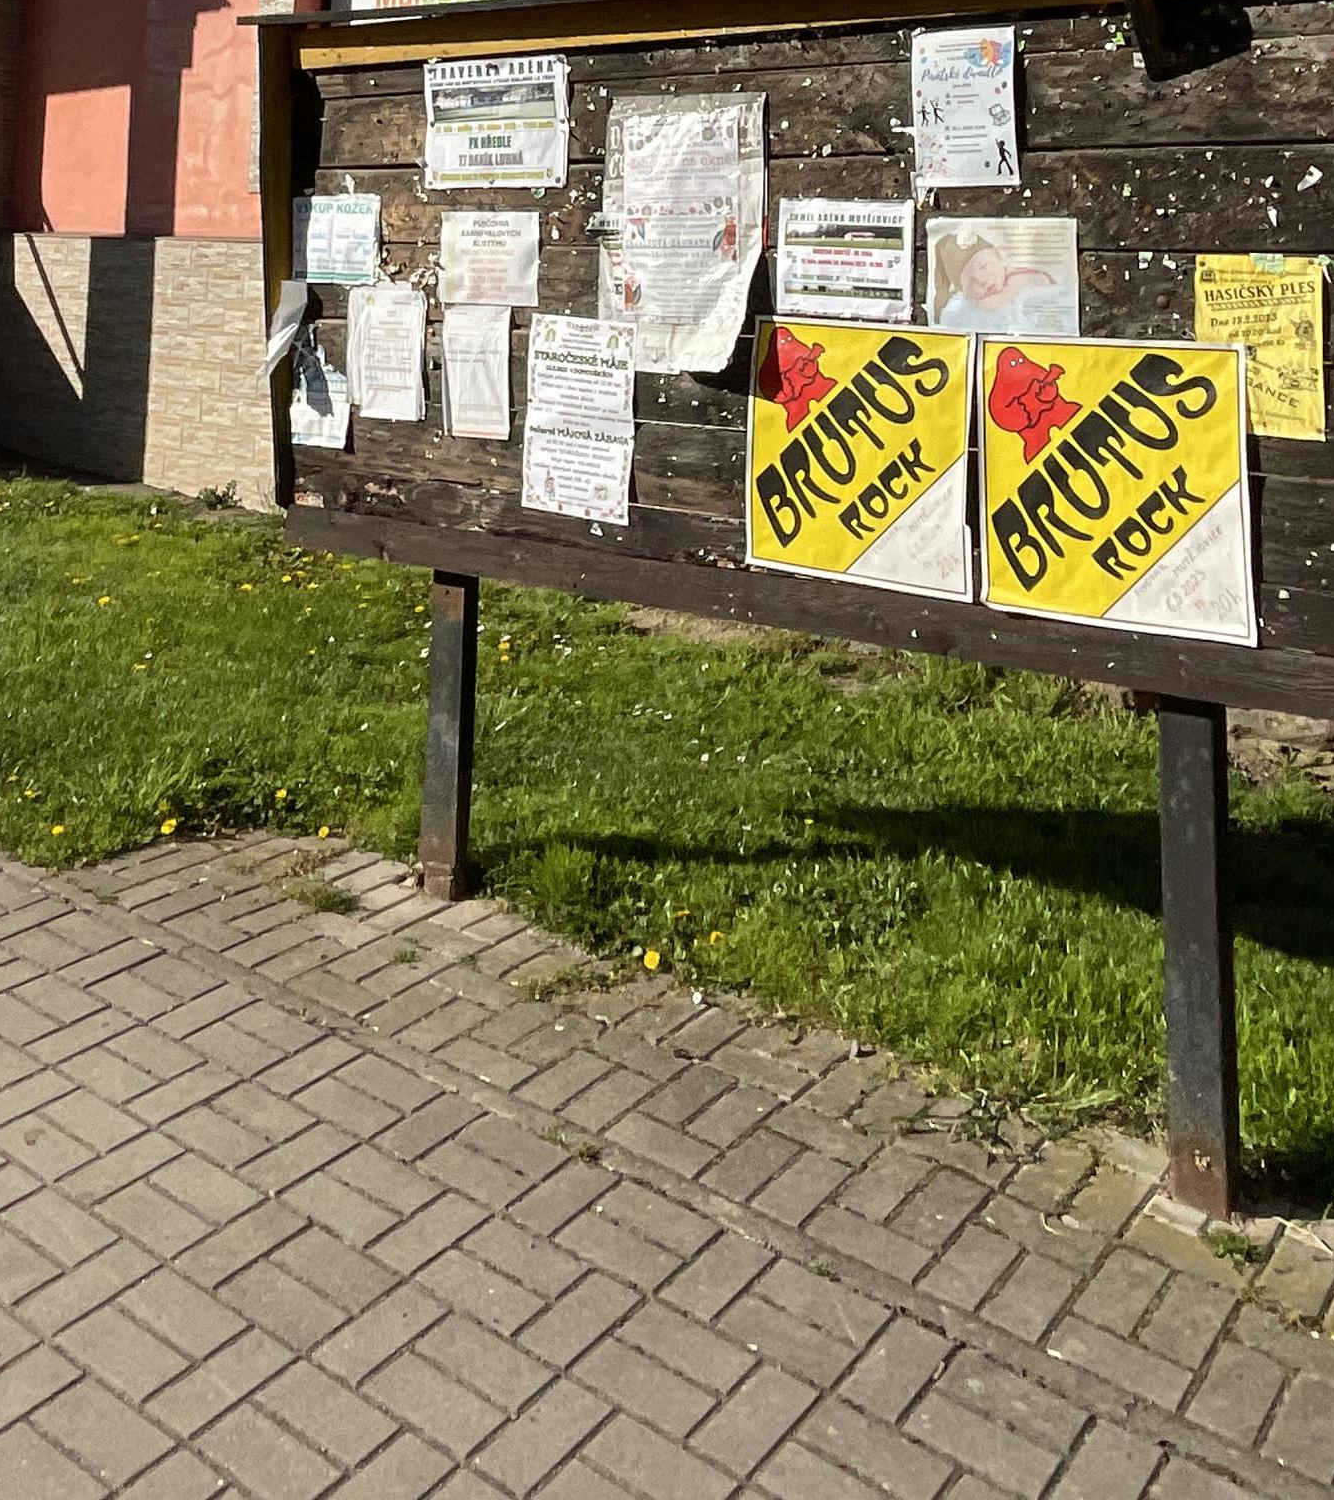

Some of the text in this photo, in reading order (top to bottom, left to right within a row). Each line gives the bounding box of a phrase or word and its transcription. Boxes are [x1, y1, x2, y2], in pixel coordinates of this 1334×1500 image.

[1280, 281, 1316, 296] PLES
[600, 356, 629, 371] MÁJE
[756, 336, 950, 548] BRUTUS
[838, 437, 937, 540] ROCK
[991, 353, 1218, 592] BRUTUS
[1092, 465, 1206, 581] ROCK
